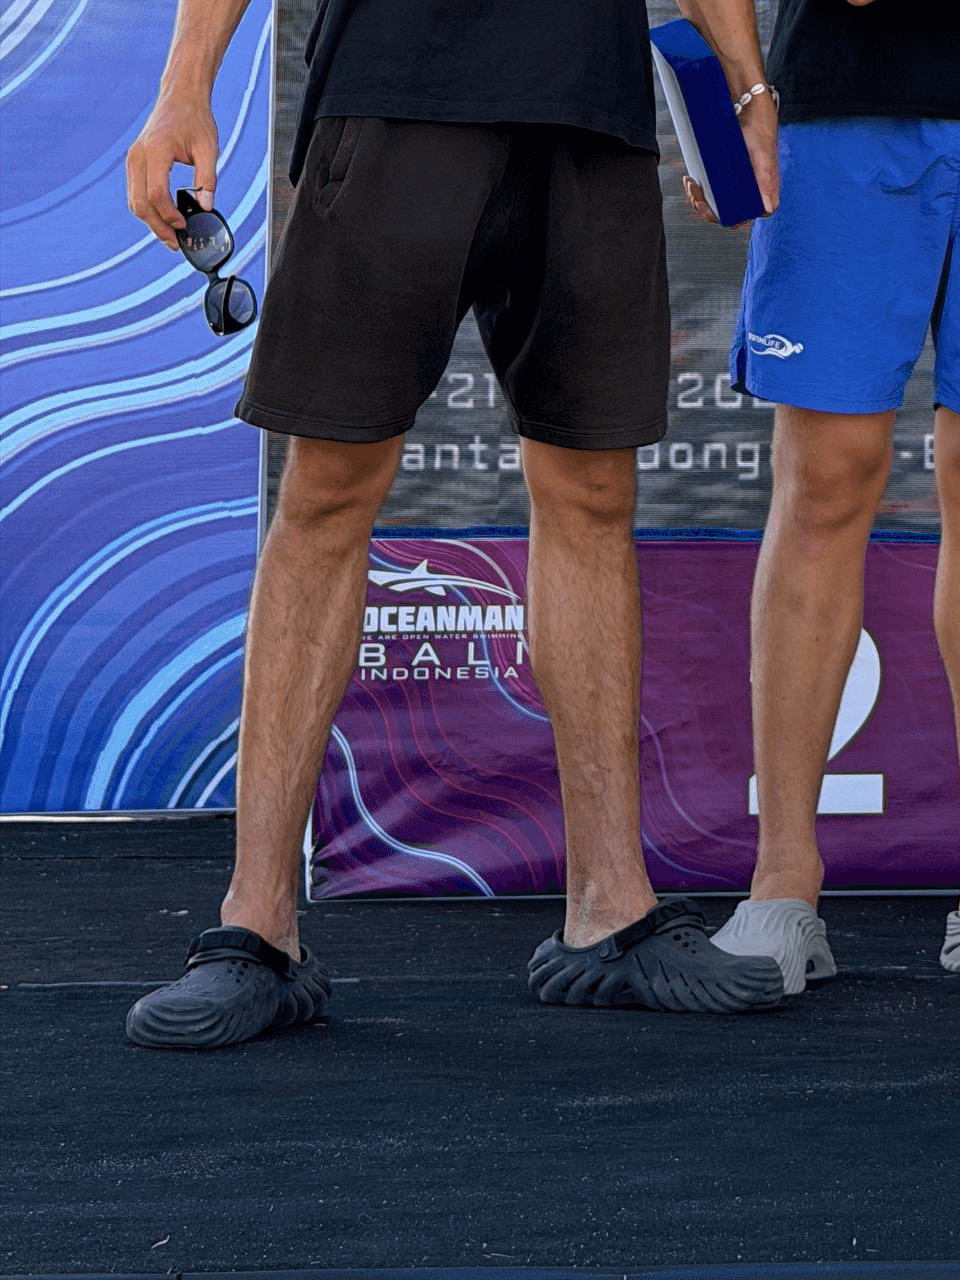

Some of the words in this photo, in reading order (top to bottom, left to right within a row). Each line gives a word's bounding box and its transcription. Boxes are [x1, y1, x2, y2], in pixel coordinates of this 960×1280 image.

[401, 435, 521, 470] anta
[362, 605, 524, 632] OCEANMAN
[358, 641, 524, 667] BALI
[360, 666, 519, 681] INDONESIA
